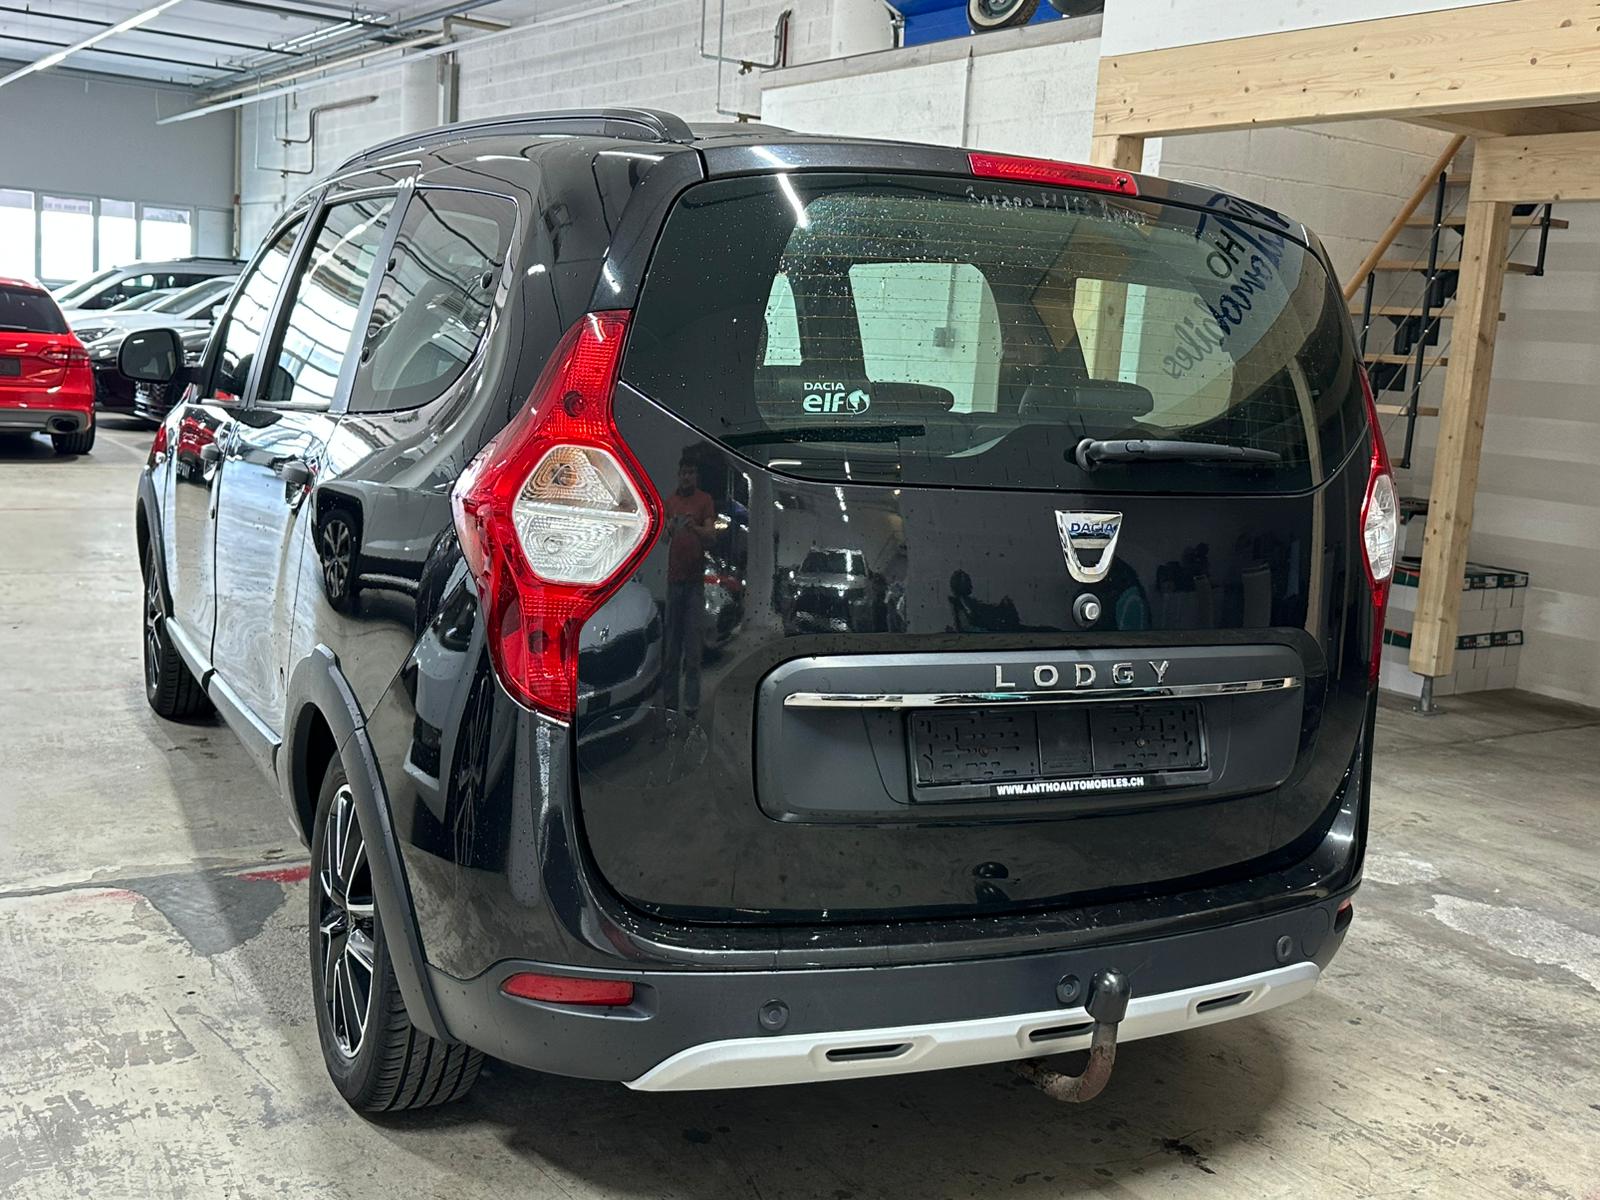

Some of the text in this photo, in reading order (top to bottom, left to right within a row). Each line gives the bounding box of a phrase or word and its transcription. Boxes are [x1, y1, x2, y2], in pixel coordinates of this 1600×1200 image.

[803, 382, 845, 391] DACIA
[803, 392, 846, 412] elf
[1071, 522, 1114, 533] DACIA
[995, 660, 1170, 688] LODGY
[996, 777, 1145, 796] WWW.ANTHOAUTOMOBILES.CH
